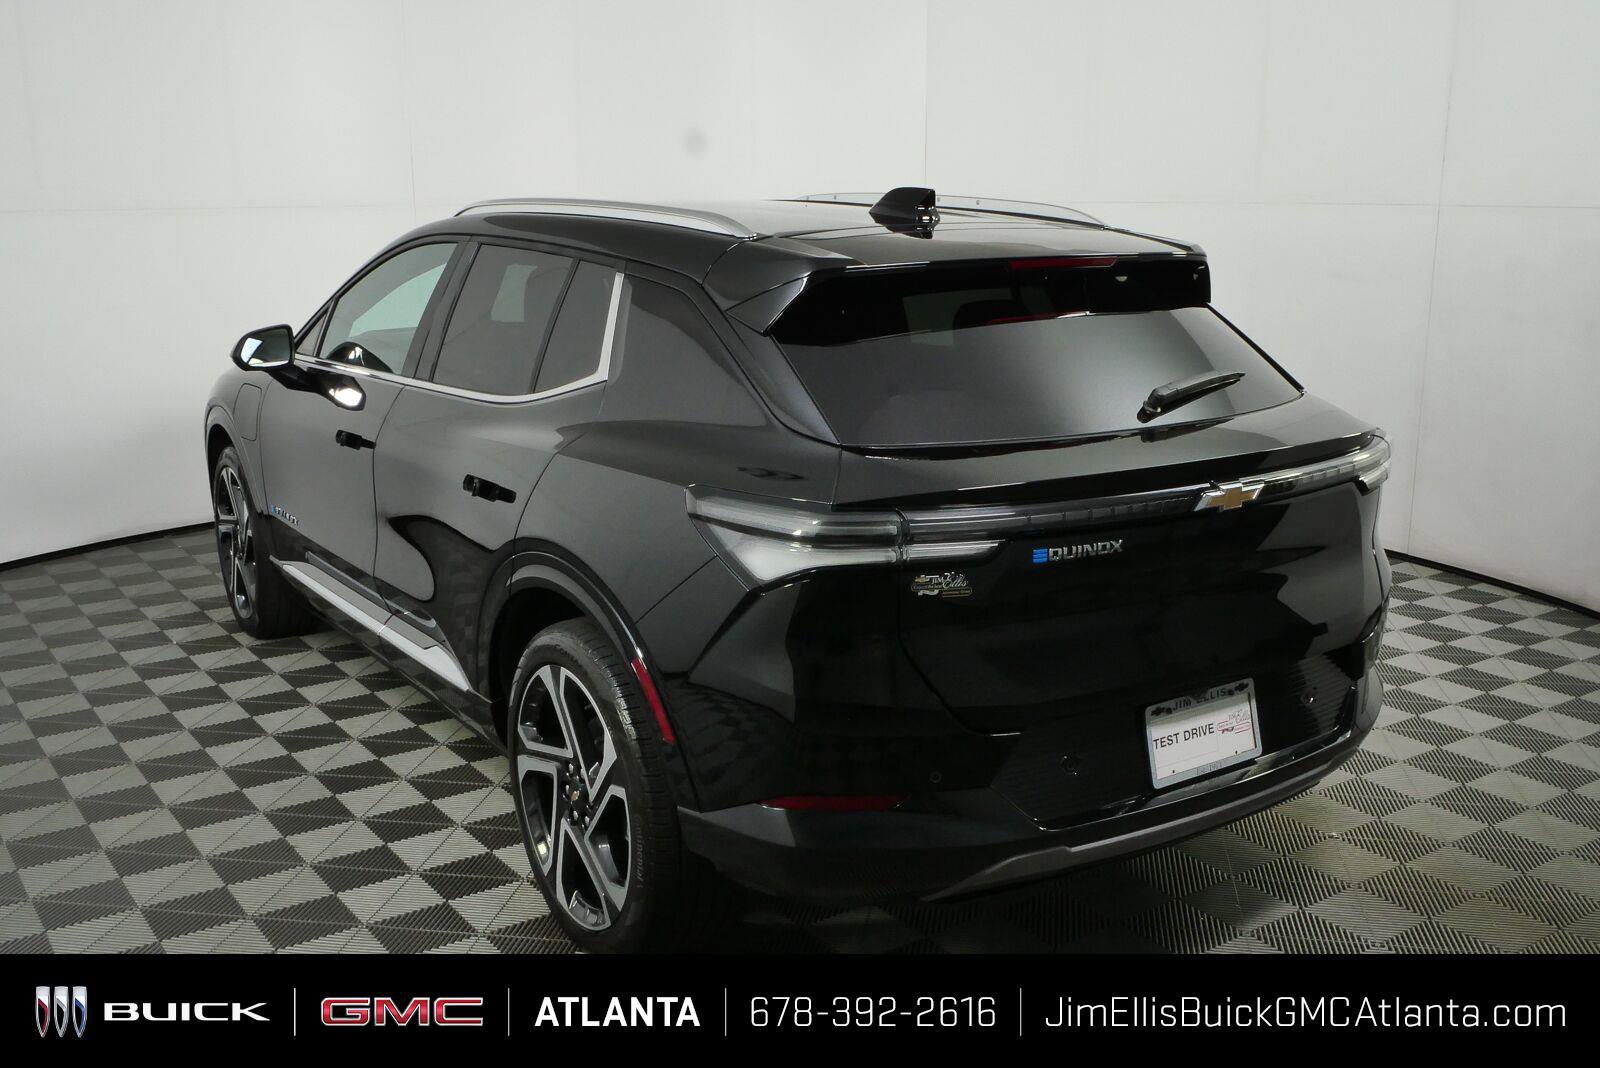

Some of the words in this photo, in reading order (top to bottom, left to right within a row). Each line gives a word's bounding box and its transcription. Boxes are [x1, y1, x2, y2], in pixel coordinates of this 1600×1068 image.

[1032, 539, 1123, 564] EQUINOX
[1172, 699, 1192, 711] JIM
[1197, 688, 1227, 704] LIS
[1153, 733, 1180, 750] TEST
[1183, 723, 1215, 742] DRIVE
